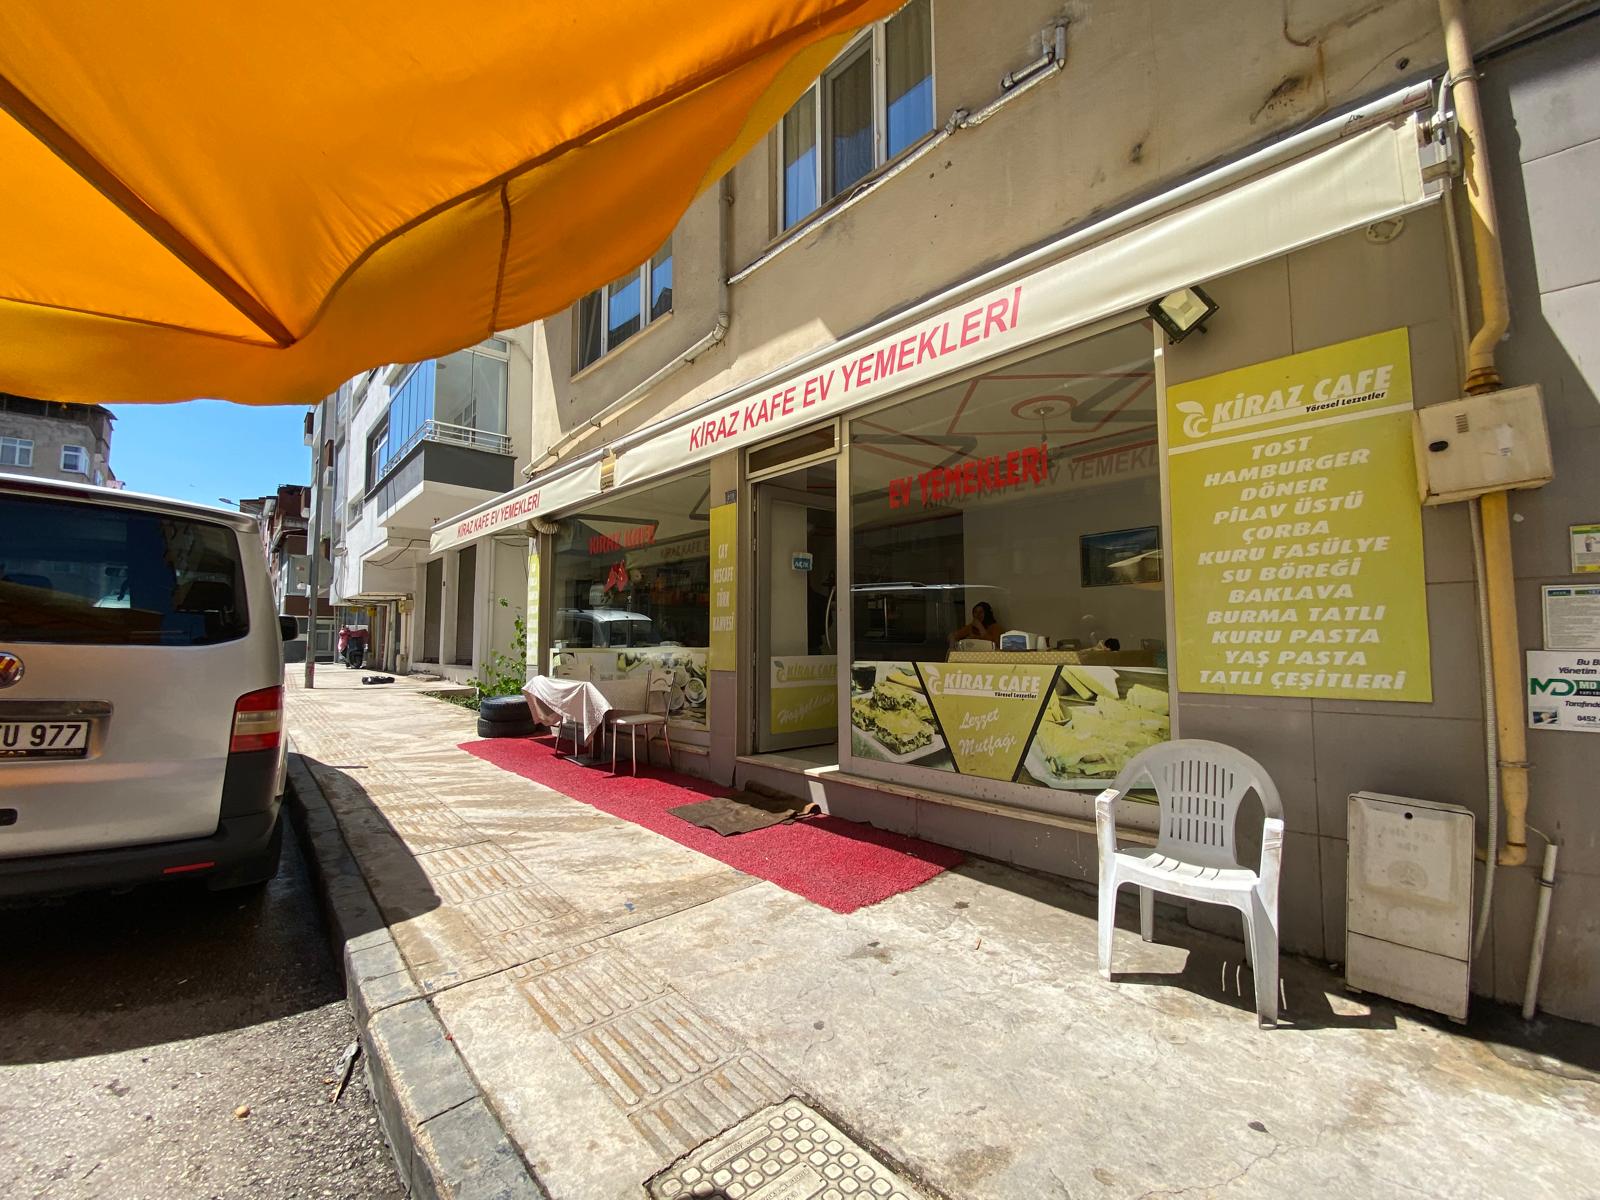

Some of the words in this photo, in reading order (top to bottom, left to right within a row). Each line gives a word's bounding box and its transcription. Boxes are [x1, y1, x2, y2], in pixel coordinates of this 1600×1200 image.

[743, 386, 796, 431] KAFE
[803, 369, 836, 408] EV
[1212, 384, 1304, 424] KİRAZ
[1313, 364, 1394, 402] CAFE
[1305, 399, 1340, 413] Yöresel
[1341, 391, 1387, 406] Lezzetler
[1252, 435, 1313, 460] TOST
[1204, 448, 1371, 487] HAMBURGER
[889, 475, 913, 509] EV
[1240, 476, 1329, 502] DÖNER
[1213, 501, 1287, 525] PİLAV
[1294, 490, 1366, 516] ÜSTÜ
[474, 513, 490, 531] KAFE
[490, 509, 501, 526] EV
[1241, 520, 1330, 545] ÇORBA
[1197, 547, 1266, 565] KURU
[1272, 536, 1391, 560] FASÜLYE
[1221, 568, 1252, 583] SU
[1259, 557, 1362, 582] BÖREĞİ
[1228, 583, 1354, 604] BAKLAVA
[1206, 608, 1299, 625] BURMA
[1309, 605, 1386, 622] TATLI
[1211, 629, 1283, 645] KURU
[1289, 628, 1381, 644] PASTA
[1225, 650, 1270, 668] YAŞ
[1277, 650, 1368, 666] PASTA
[1577, 658, 1590, 666] Bu
[944, 670, 993, 691] KİRAZ
[998, 675, 1041, 693] CAFE
[1199, 670, 1263, 685] TATLI
[1270, 669, 1407, 691] ÇEŞİTLERİ
[1579, 681, 1597, 689] MD
[0, 724, 20, 747] U
[30, 724, 82, 747] 977
